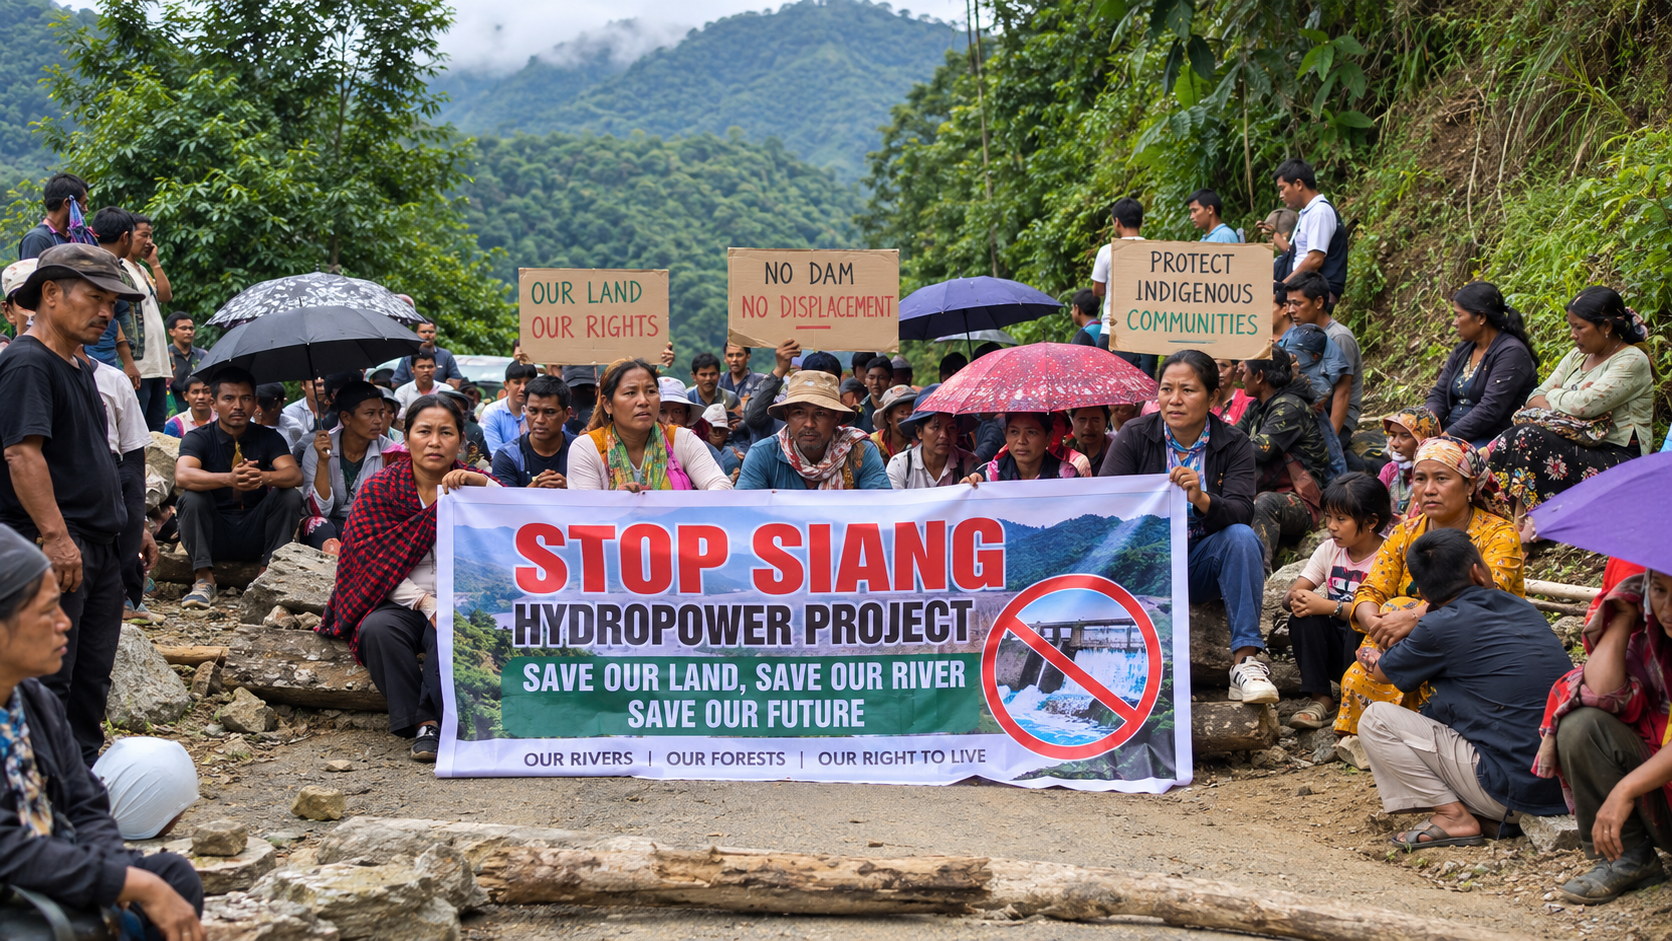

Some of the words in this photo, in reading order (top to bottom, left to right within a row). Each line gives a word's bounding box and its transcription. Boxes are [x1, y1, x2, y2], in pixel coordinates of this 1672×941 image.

[766, 262, 792, 284] NO
[810, 262, 853, 284] DAM
[1151, 251, 1234, 274] PROTECT
[532, 282, 574, 304] OUR
[589, 281, 641, 303] LAND
[1135, 280, 1252, 304] INDIGENOUS
[743, 296, 768, 318] NO
[781, 296, 893, 318] DISPLACEMENT
[532, 316, 574, 338] OUR
[587, 315, 658, 338] RIGHTS
[1127, 309, 1258, 335] COMMUNITIES
[515, 522, 728, 595] STOP
[752, 518, 1004, 594] SIANG
[513, 603, 792, 647] HYDROPOWER
[806, 600, 972, 644] PROJECT
[523, 664, 593, 691] SAVE
[605, 663, 659, 691] OUR
[670, 663, 746, 697] LAND,
[756, 664, 821, 691] SAVE
[832, 663, 882, 690] OUR
[893, 661, 965, 689] RIVER
[628, 700, 695, 728] SAVE
[706, 700, 758, 727] OUR
[768, 699, 864, 727] FUTURE
[525, 753, 563, 766] OUR
[571, 752, 632, 765] RIVERS
[667, 752, 705, 765] OUR
[712, 752, 785, 765] FORESTS
[819, 752, 857, 766] OUR
[863, 751, 916, 765] RIGHT
[921, 750, 945, 764] TO
[951, 749, 986, 763] LIVE
